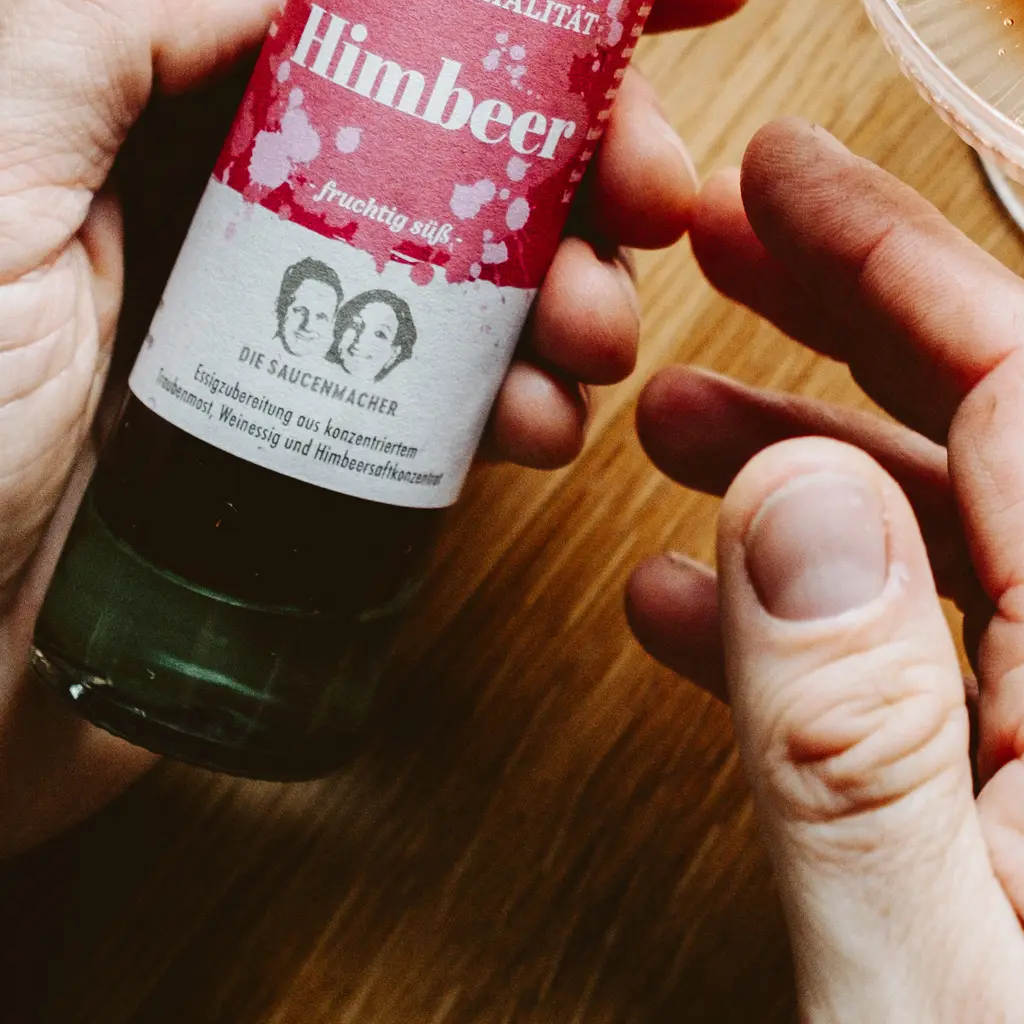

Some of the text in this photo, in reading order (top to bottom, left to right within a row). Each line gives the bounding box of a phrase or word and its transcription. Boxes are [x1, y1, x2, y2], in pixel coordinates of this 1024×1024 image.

[290, 3, 576, 160] Himbeer
[313, 180, 453, 245] fruchtig süß
[194, 364, 418, 459] Essigzubereitung aus konzentriertem
[239, 346, 398, 416] DIE SAUCENMACHER
[219, 403, 280, 449] Weinessig
[284, 433, 312, 458] und
